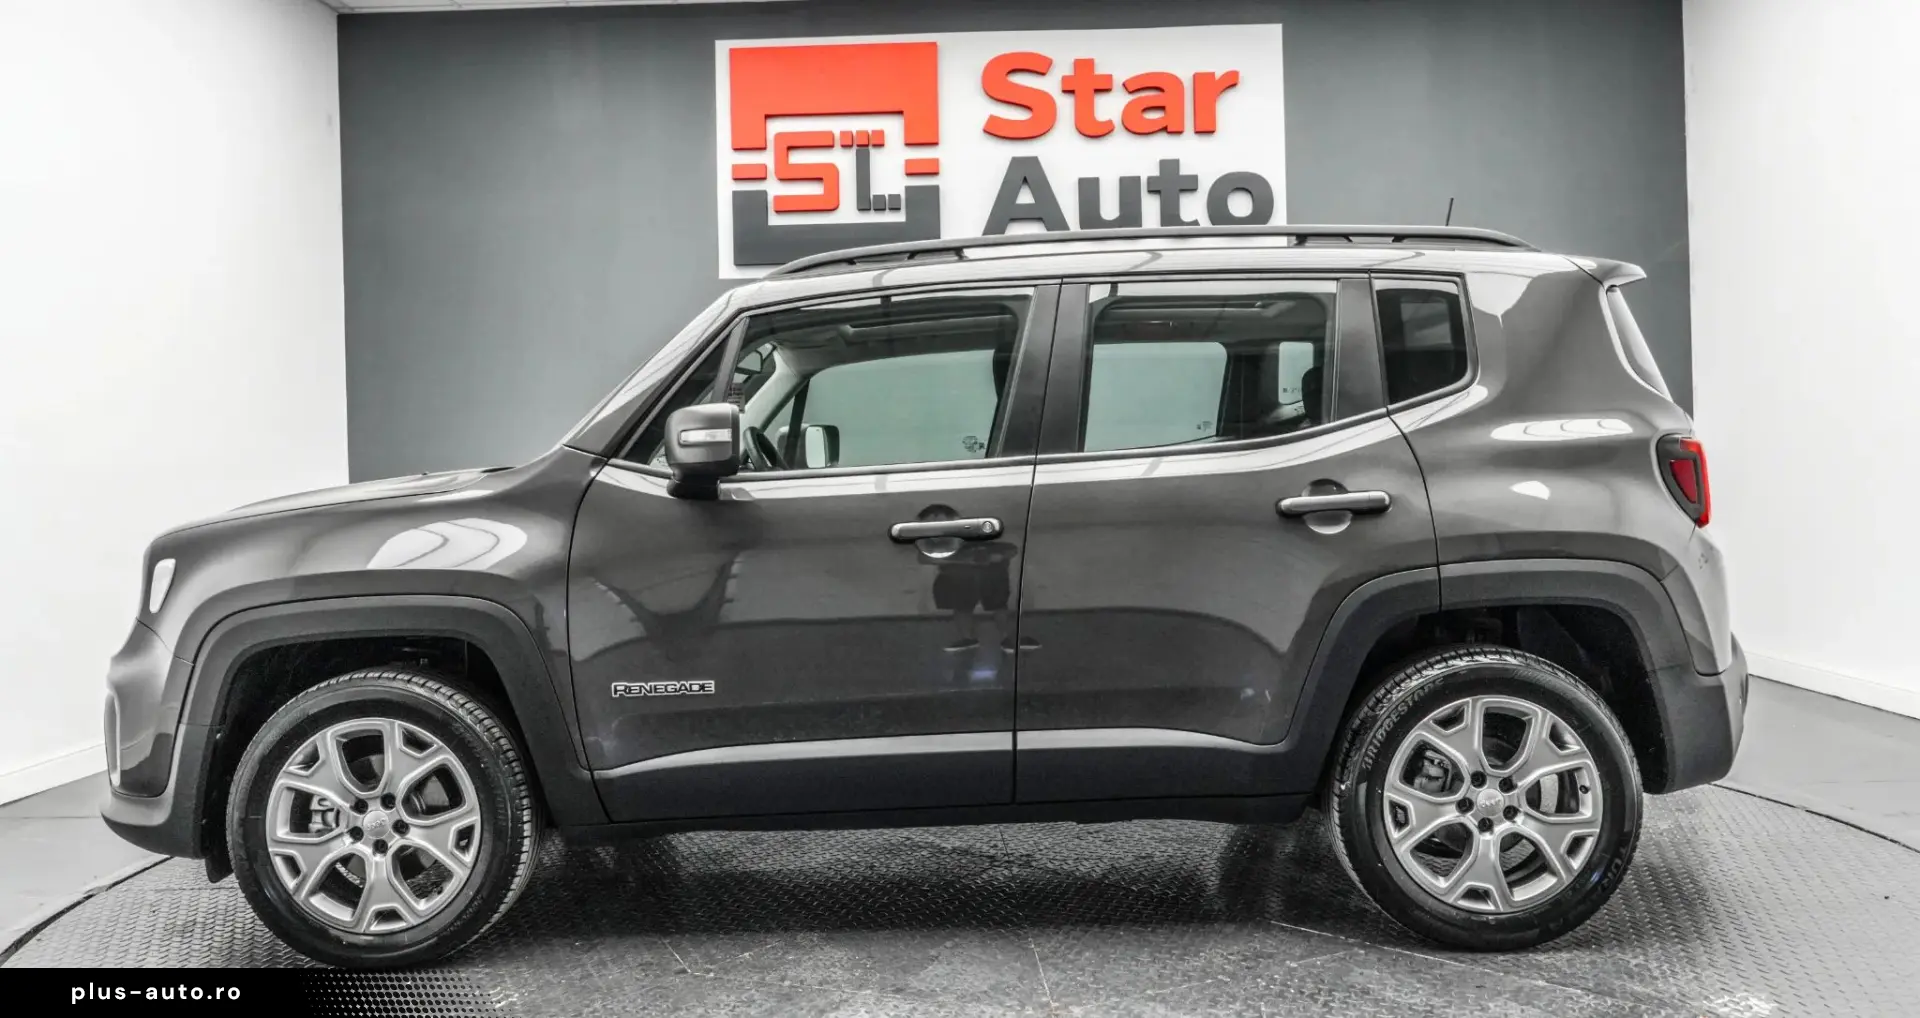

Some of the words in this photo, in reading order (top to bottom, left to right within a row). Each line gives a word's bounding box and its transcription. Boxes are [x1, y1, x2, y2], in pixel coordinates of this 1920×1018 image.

[981, 51, 1239, 140] Star
[982, 156, 1274, 235] Auto
[611, 680, 715, 697] RENEGADE
